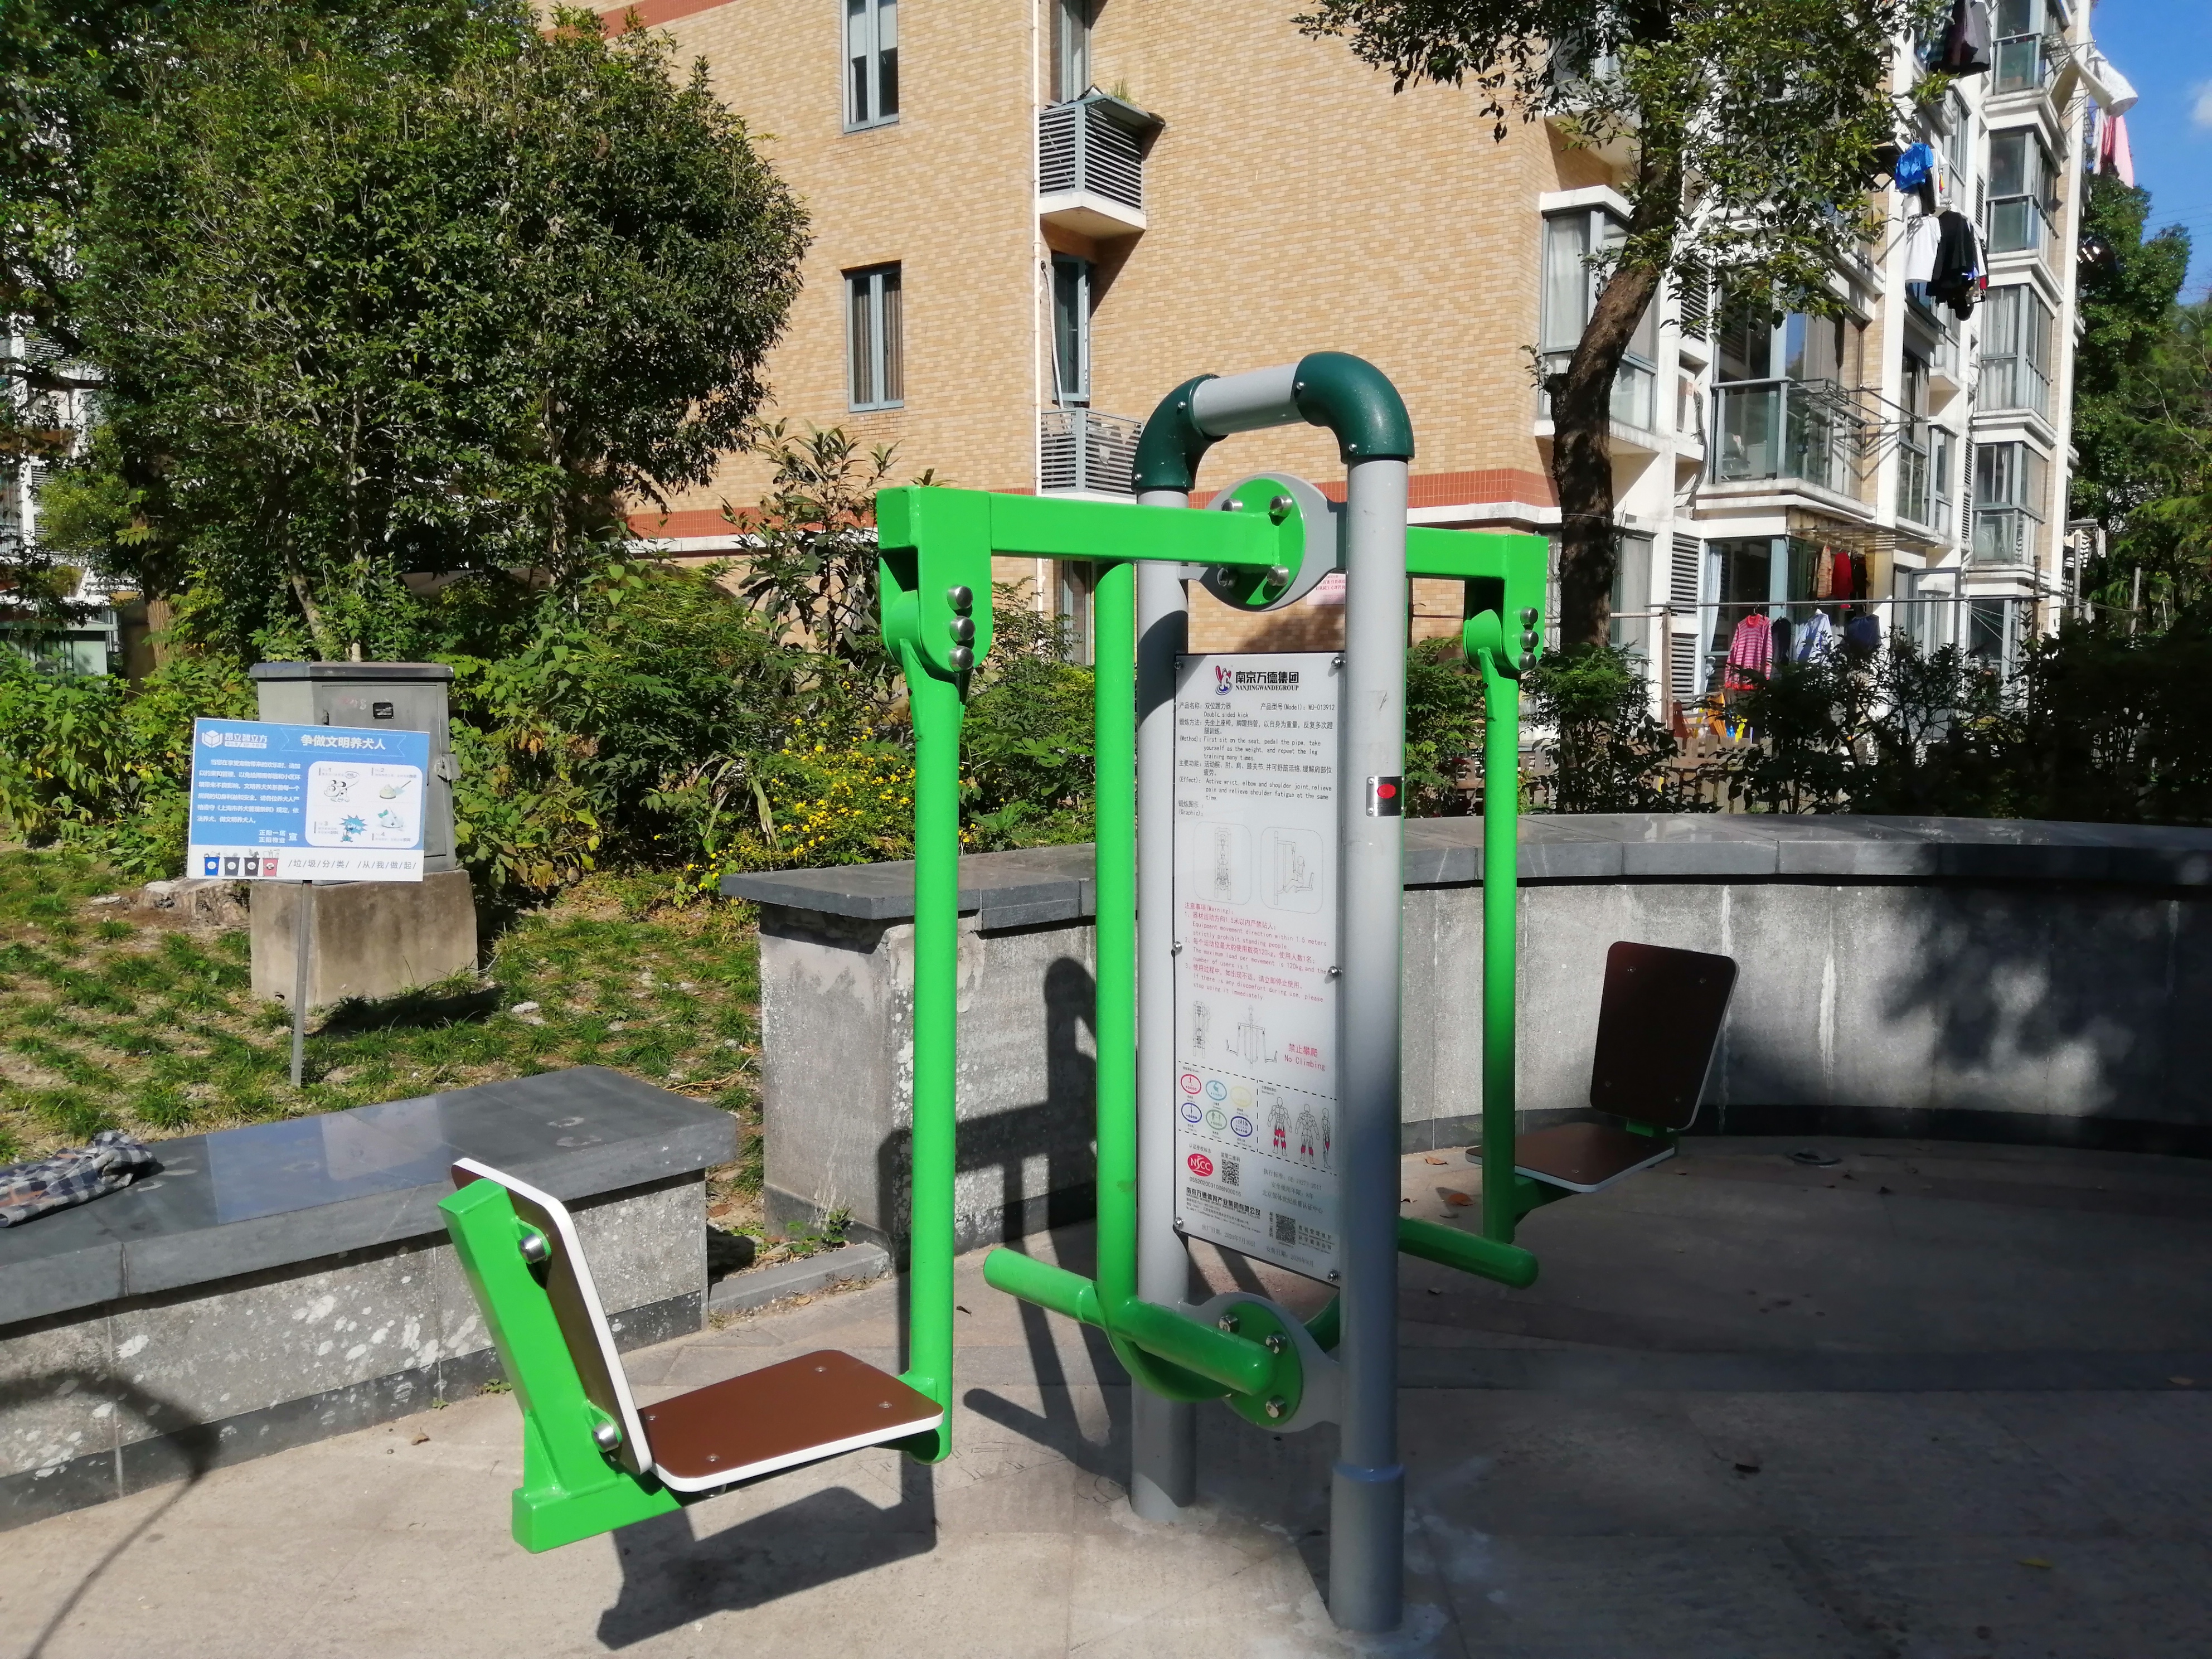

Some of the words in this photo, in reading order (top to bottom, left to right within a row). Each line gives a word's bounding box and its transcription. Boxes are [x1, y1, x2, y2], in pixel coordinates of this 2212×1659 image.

[1235, 671, 1299, 684] 南京万德集团
[225, 733, 268, 743] 昂立智立方
[300, 734, 386, 751] 争做文明养犬人
[289, 833, 298, 841] 宣
[1192, 920, 1217, 930] Equipment
[1245, 929, 1272, 938] direction
[1193, 930, 1215, 939] strictly
[1243, 938, 1266, 947] standing
[1251, 958, 1275, 966] movement
[1237, 982, 1266, 992] discomfort
[1269, 988, 1287, 996] during
[1304, 994, 1323, 1002] please
[1288, 1043, 1318, 1058] 禁止攀爬
[1284, 1054, 1292, 1063] No
[1295, 1058, 1326, 1071] Climbing
